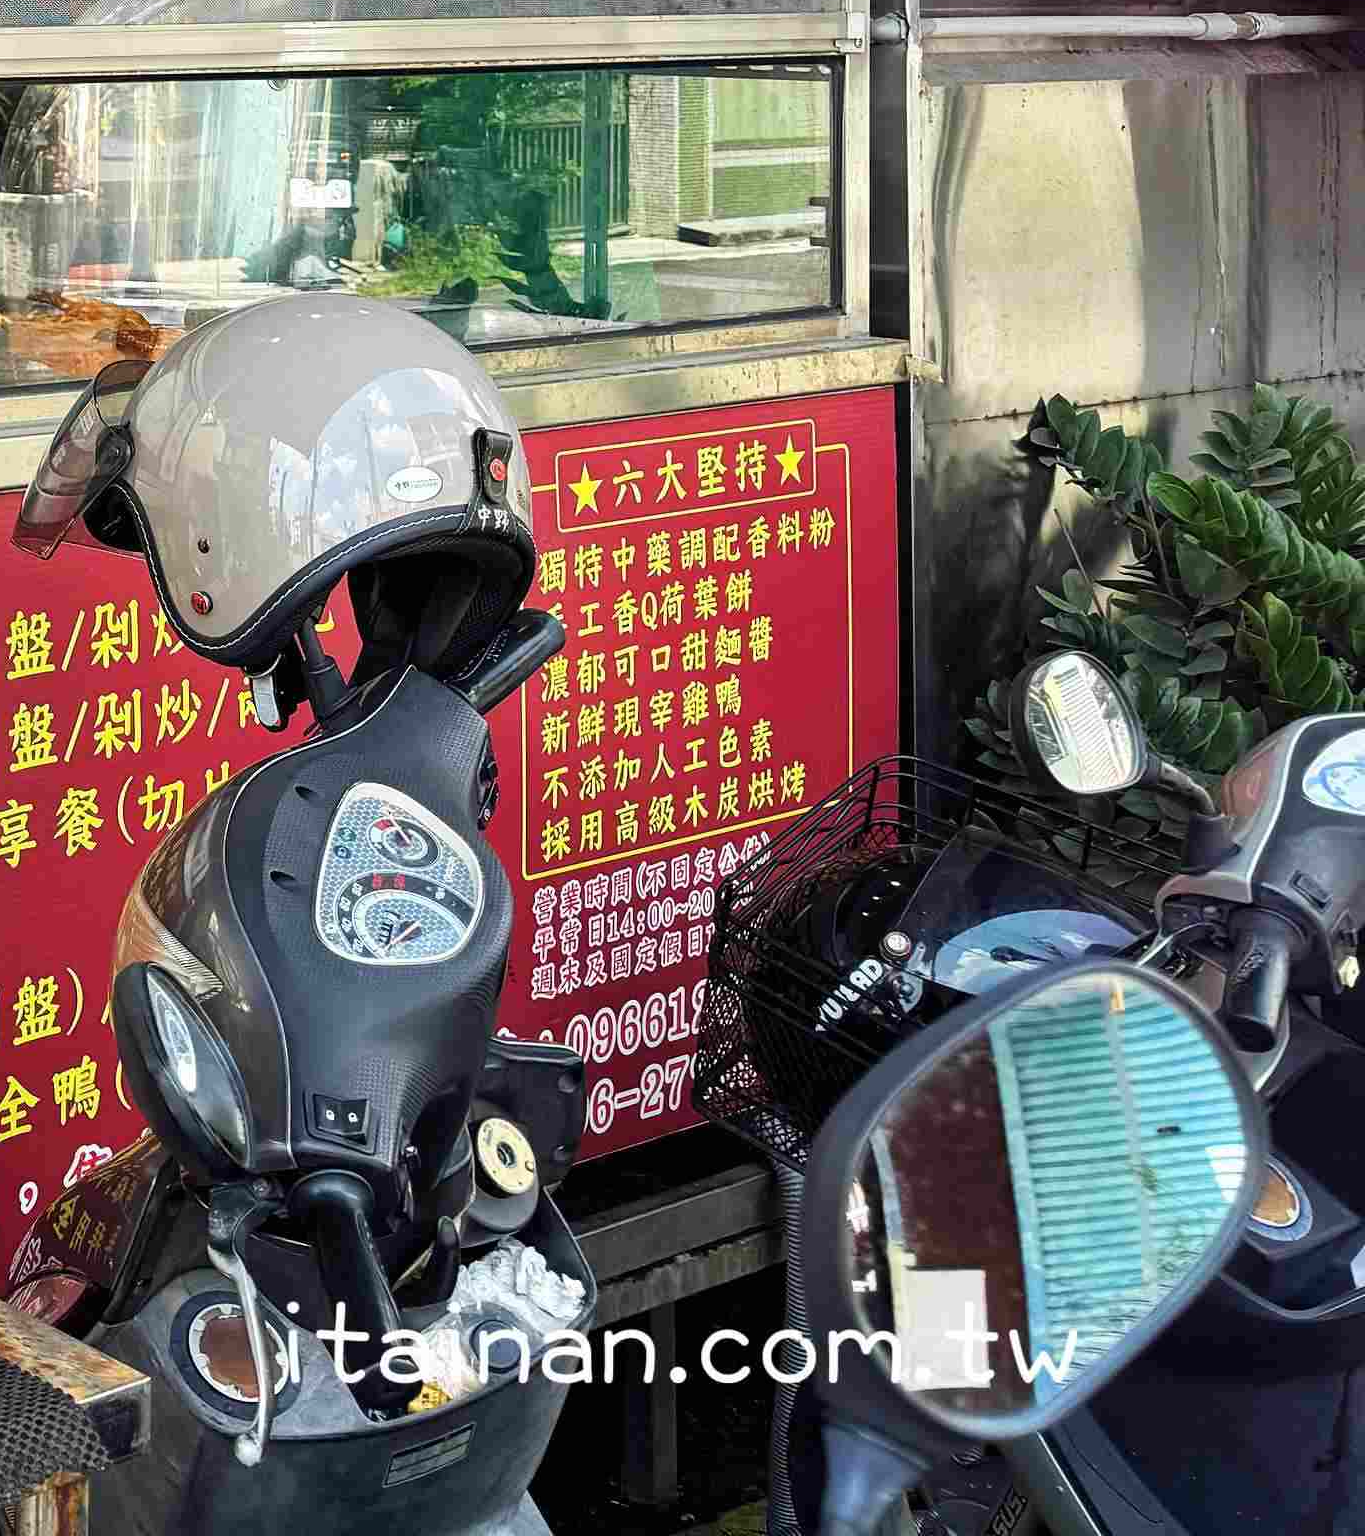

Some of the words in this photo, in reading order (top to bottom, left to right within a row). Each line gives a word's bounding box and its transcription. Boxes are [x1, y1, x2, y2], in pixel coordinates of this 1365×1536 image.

[613, 439, 767, 507] 六大堅持
[538, 507, 836, 595] 獨特中藥調配香料粉
[541, 615, 774, 704] 濃郁可口甜麵醬
[541, 677, 742, 755] 新鮮現宰雞鴨
[541, 718, 774, 810] 不添加人工色素
[540, 762, 806, 863] 採用高級木炭烘烤
[584, 1051, 698, 1136] 6-27
